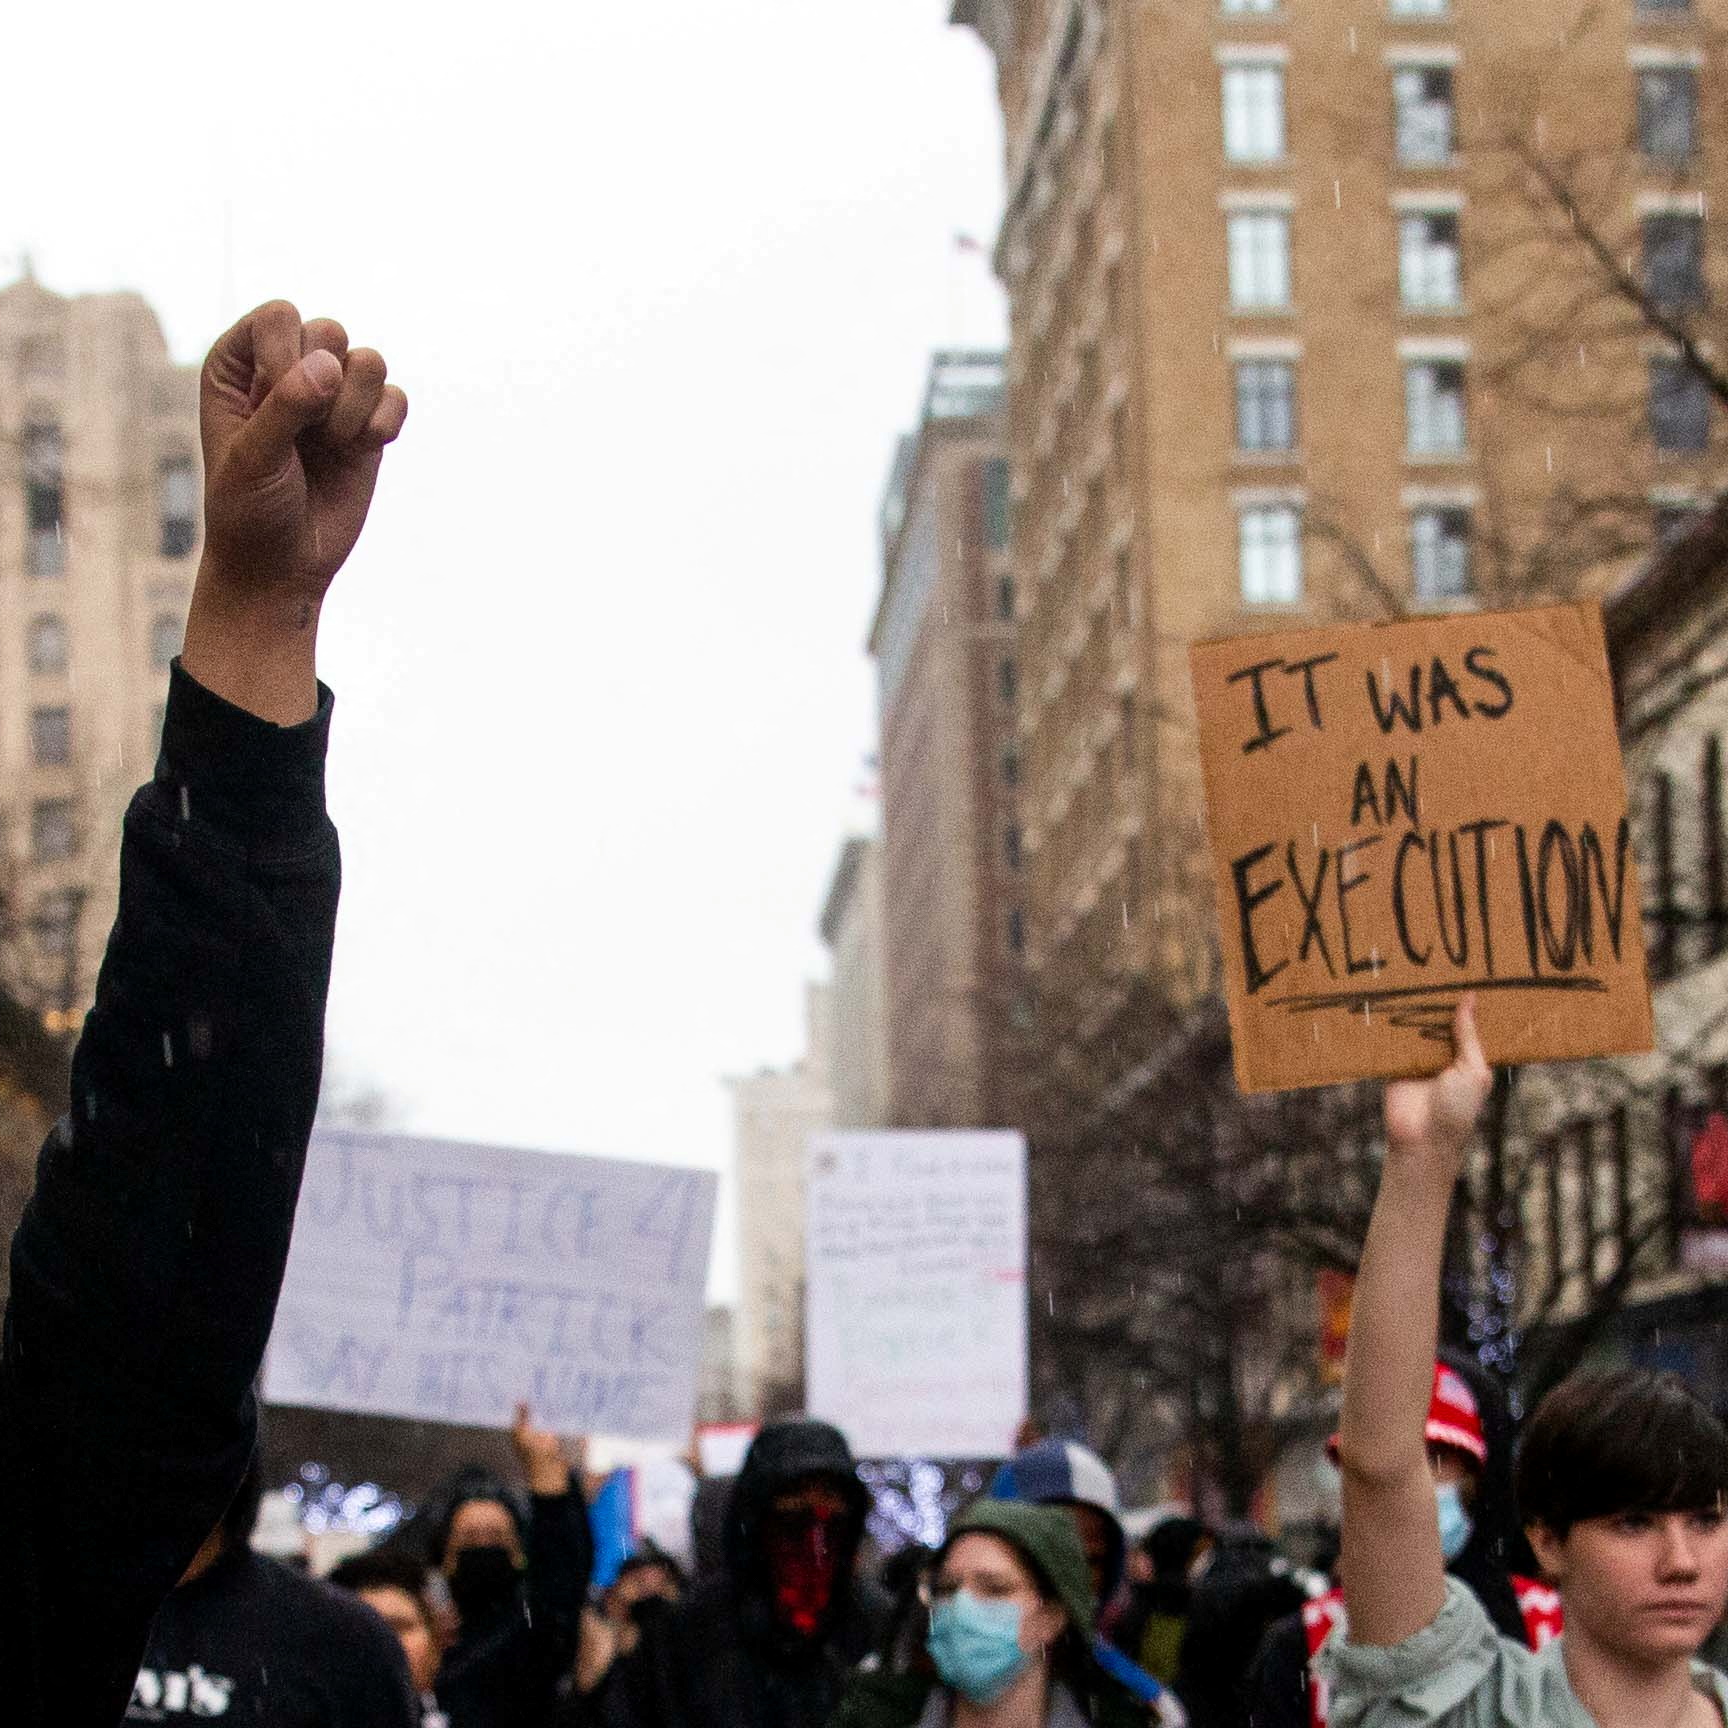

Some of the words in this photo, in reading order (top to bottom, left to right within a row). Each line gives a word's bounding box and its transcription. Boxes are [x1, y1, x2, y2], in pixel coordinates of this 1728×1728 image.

[1225, 651, 1340, 755] IT
[1365, 645, 1516, 735] WAS
[1350, 754, 1420, 829] AN
[1230, 816, 1632, 996] EXECUTION
[632, 1171, 700, 1297] 4
